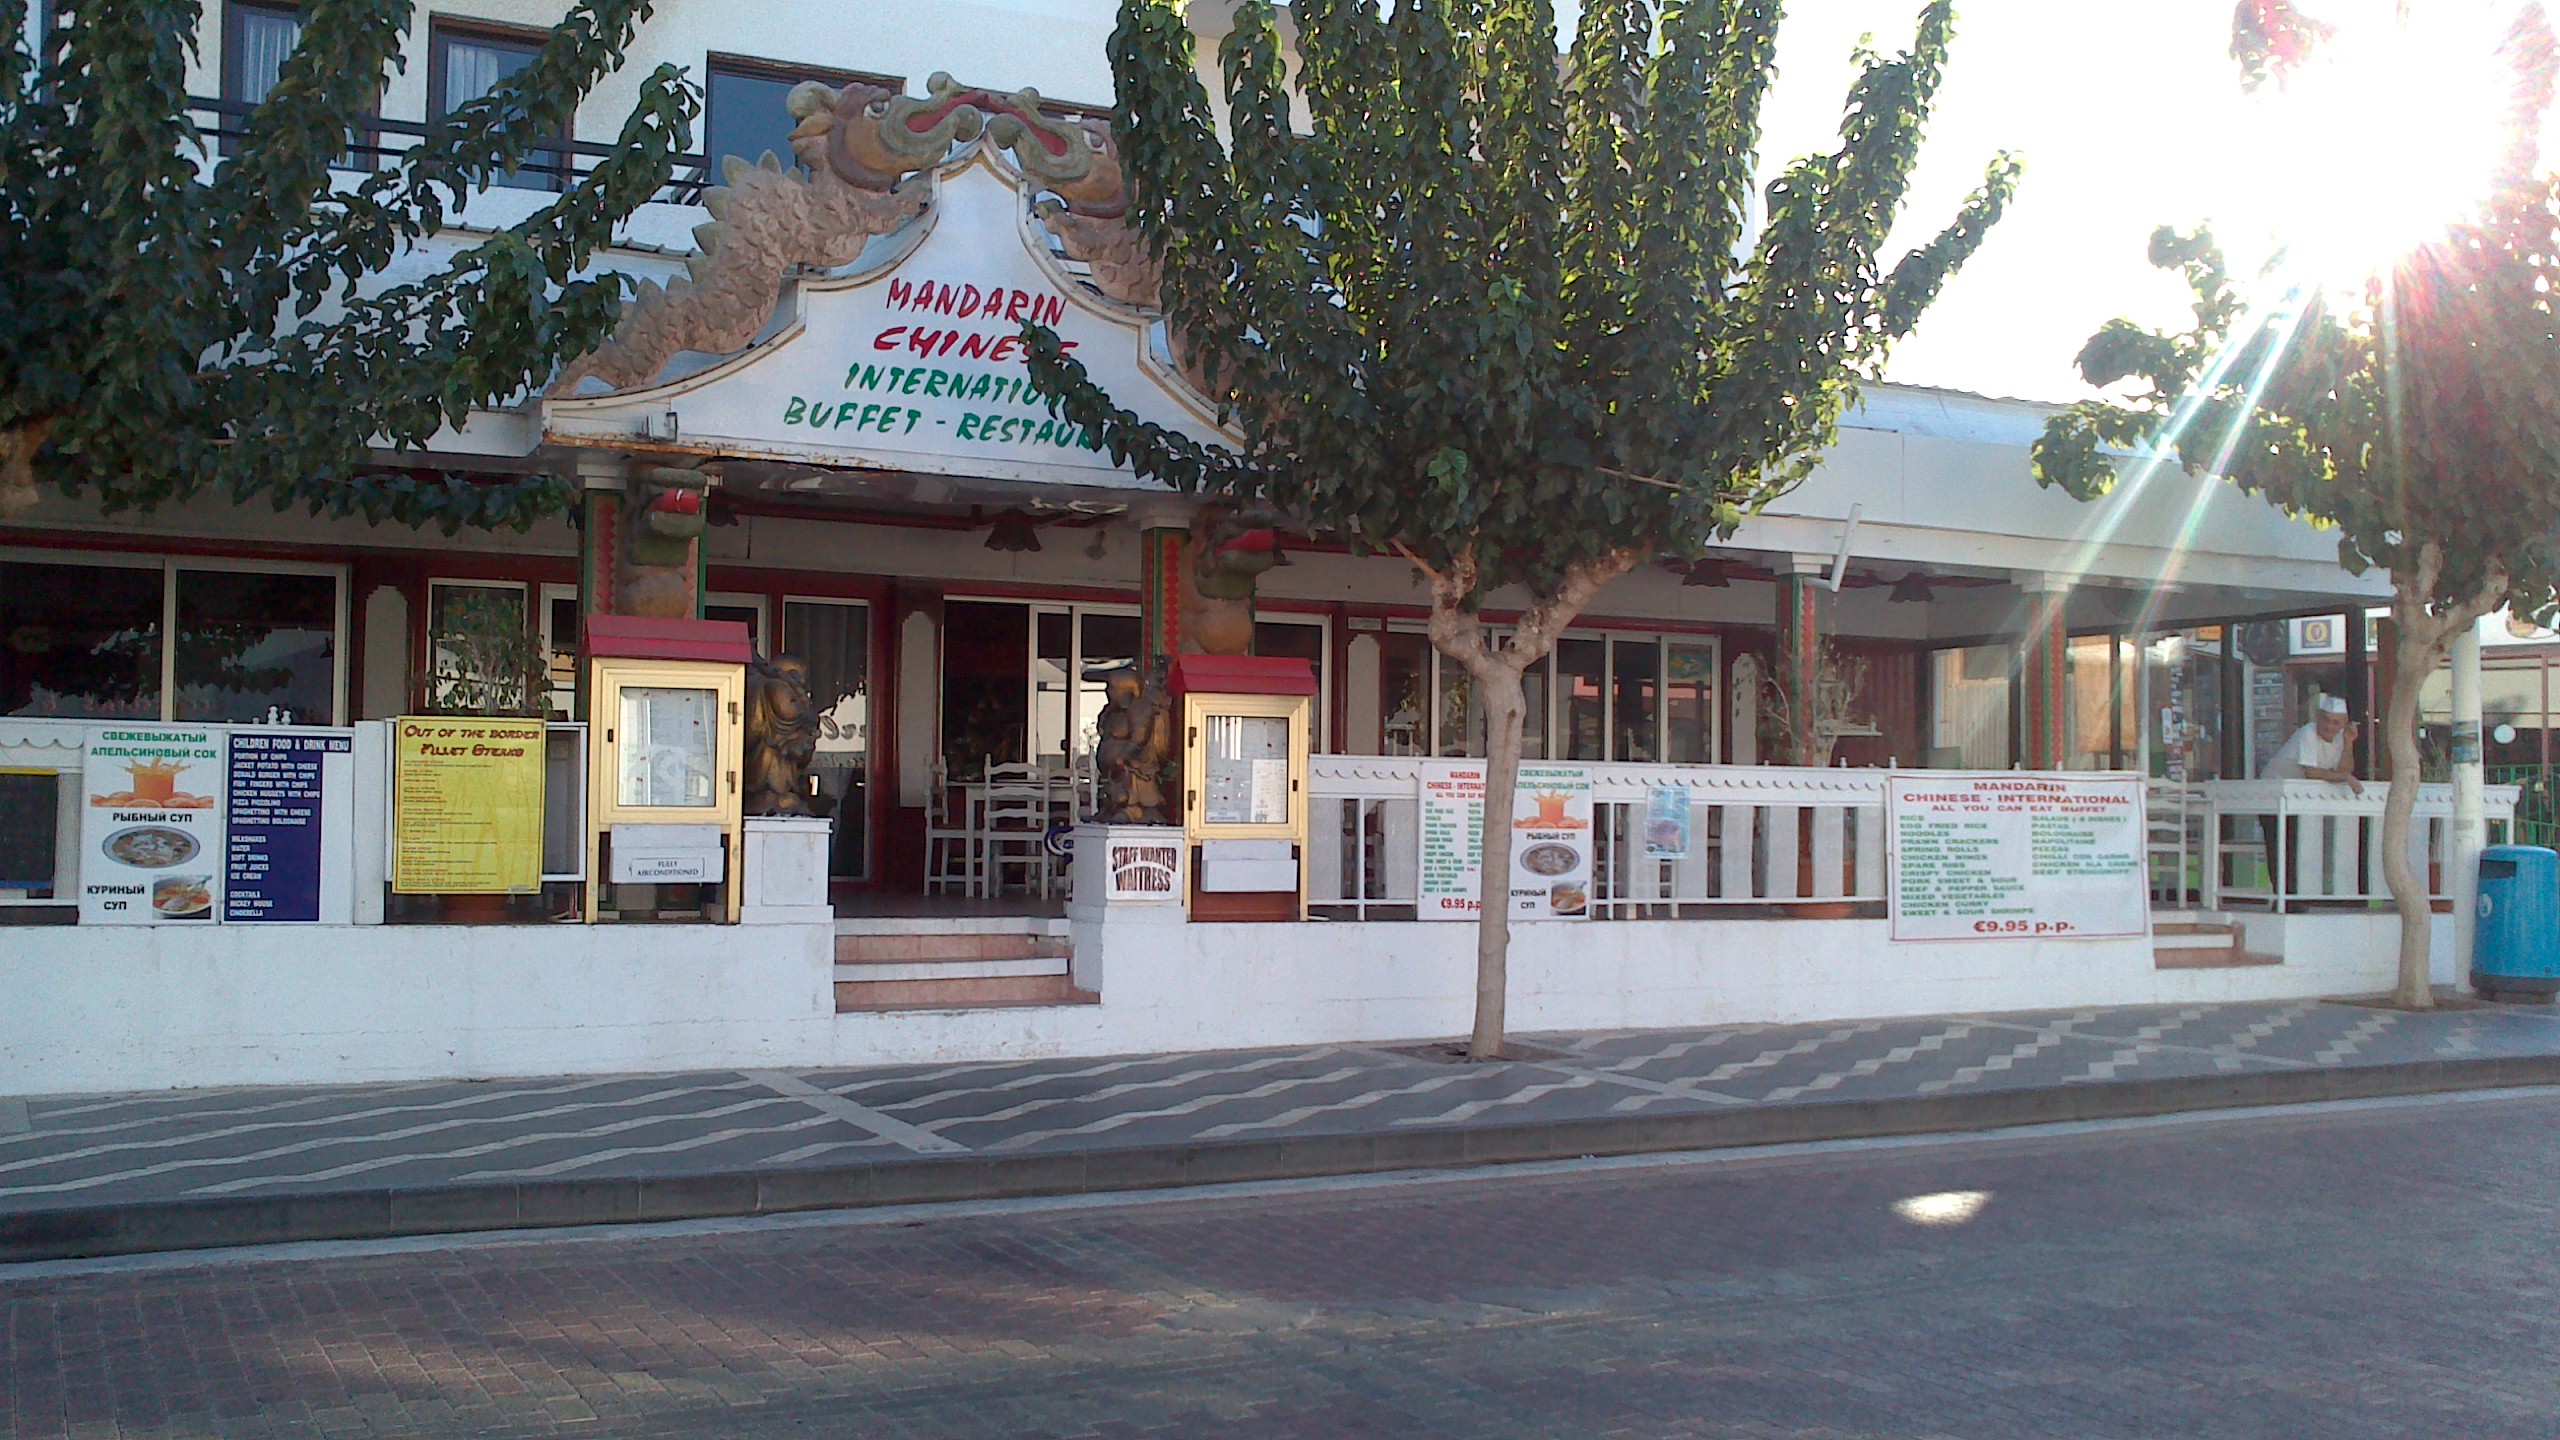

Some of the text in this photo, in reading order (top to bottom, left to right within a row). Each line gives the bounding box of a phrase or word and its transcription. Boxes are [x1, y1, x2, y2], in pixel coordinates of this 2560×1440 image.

[886, 277, 1067, 327] MANDARIN
[844, 362, 1104, 406] INTERNATIO
[783, 396, 922, 435] BUFFET
[956, 412, 1120, 451] RESTAUR
[102, 731, 207, 743] СВЕЖЕВЫЖАТЫЙ
[233, 738, 349, 751] CHILDREN FOOD & DRINK MENU
[91, 746, 217, 759] АПЕЛЬСИНОВЫЙ СОК
[1575, 782, 1589, 790] СОК
[1973, 782, 2066, 792] MANDARIN
[1903, 793, 1981, 803] CHINESE
[1997, 793, 2130, 804] INTERNATIONAL
[112, 811, 192, 823] РЫБНЫЙ СУП
[1526, 831, 1560, 840] РЫБНЫЙ
[1112, 846, 1177, 872] STAFF WANTED
[1115, 866, 1171, 892] WAITRESS
[87, 883, 145, 895] КУРИНЫЙ
[103, 901, 127, 911] СУП
[1441, 898, 1482, 911] €9.95 p.p
[1520, 901, 1535, 909] СУП
[1973, 920, 2075, 934] €9.95 p.p.
